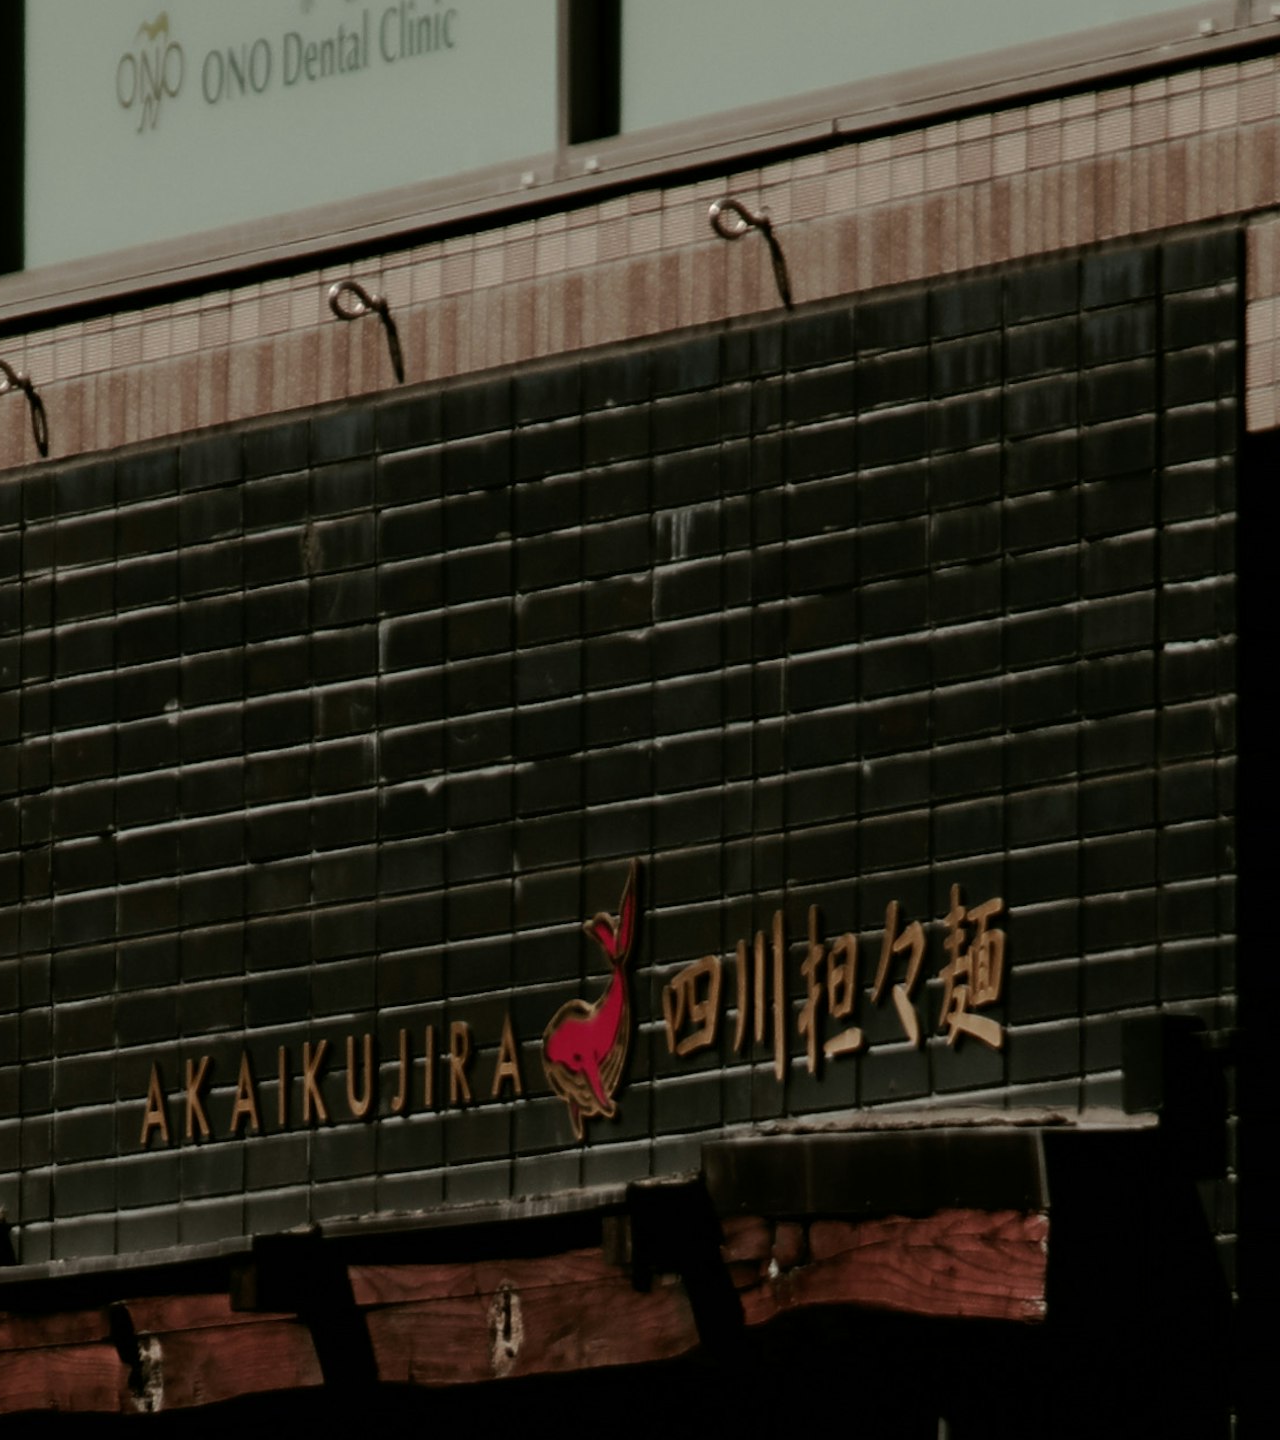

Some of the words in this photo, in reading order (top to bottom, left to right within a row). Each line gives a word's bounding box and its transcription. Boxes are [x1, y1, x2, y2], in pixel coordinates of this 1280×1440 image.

[202, 37, 272, 104] ONO
[282, 9, 370, 86] Dental
[662, 881, 1010, 1083] 四川担々麺
[139, 1011, 522, 1146] AKAIKUJIRA
